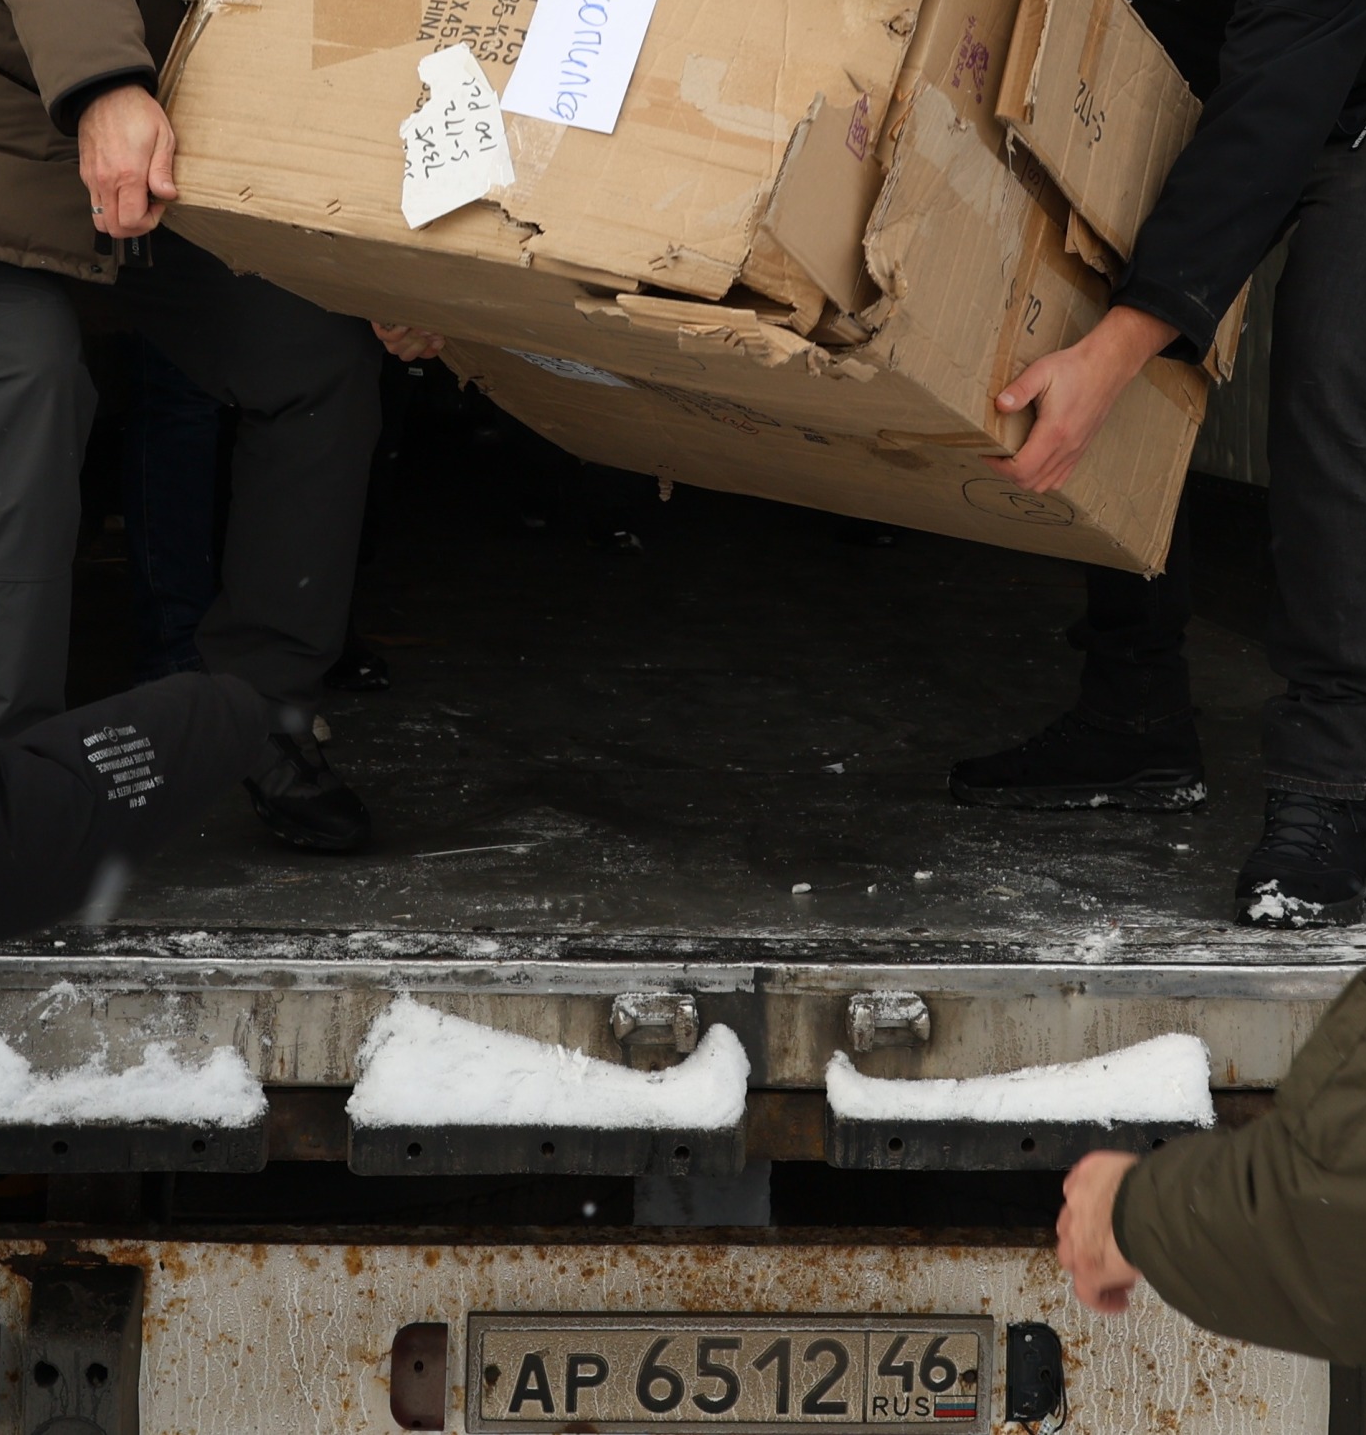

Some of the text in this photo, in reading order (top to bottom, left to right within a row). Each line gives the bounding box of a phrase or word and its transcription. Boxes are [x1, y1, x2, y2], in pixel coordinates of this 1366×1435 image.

[444, 100, 469, 162] S-172
[635, 1335, 850, 1415] 6512
[877, 1334, 958, 1394] 46
[872, 1395, 931, 1417] RUS
